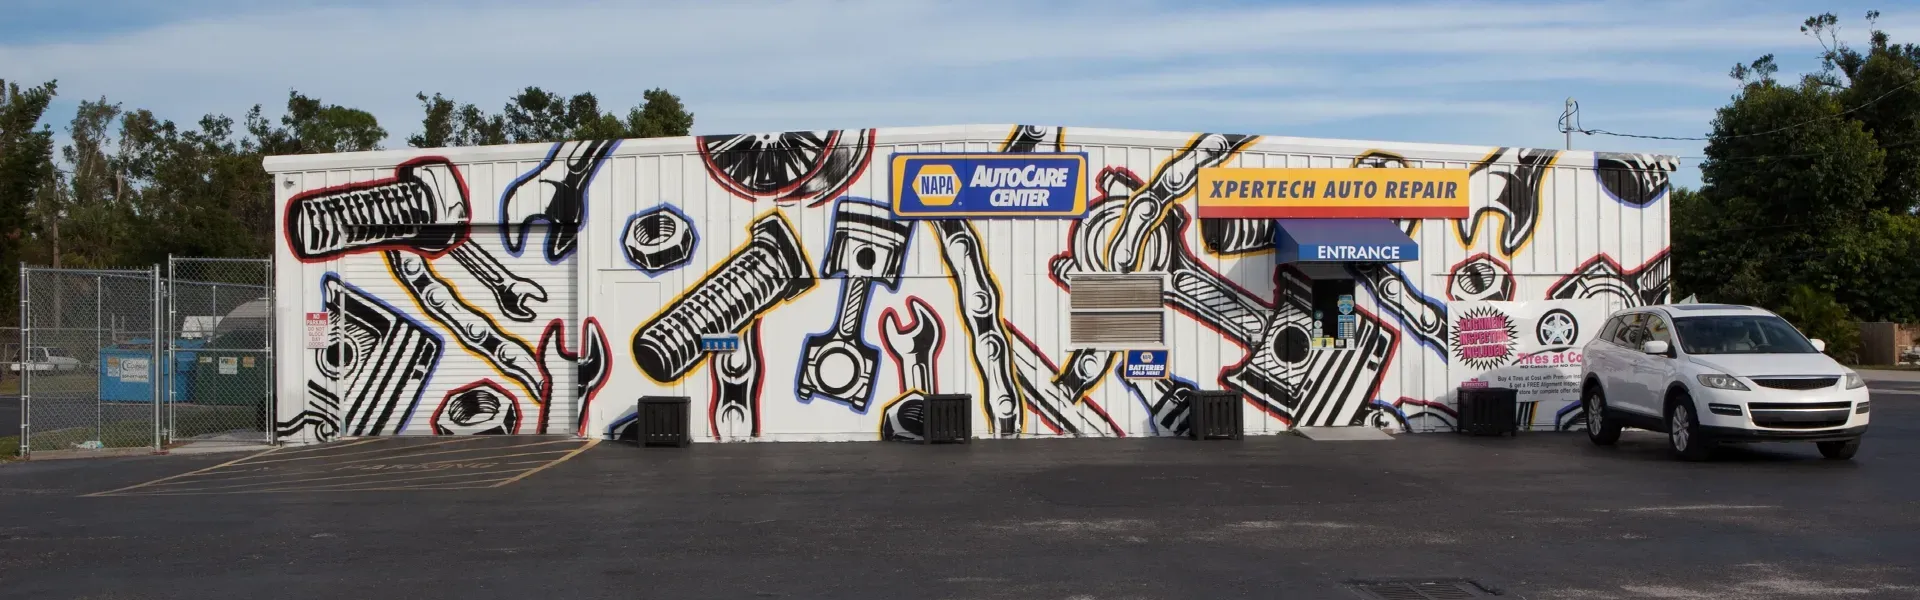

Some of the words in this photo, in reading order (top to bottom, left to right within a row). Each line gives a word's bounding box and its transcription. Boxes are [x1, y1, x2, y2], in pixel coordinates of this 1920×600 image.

[921, 175, 954, 195] NAPA
[1209, 180, 1317, 199] XPERTECH
[1323, 180, 1378, 199] AUTO
[1384, 181, 1458, 199] REPAIR
[989, 188, 1050, 207] CENTER
[1317, 245, 1400, 260] ENTRANCE
[1460, 316, 1506, 331] ALIGNMENT
[1460, 330, 1508, 345] INSPECTION
[1463, 345, 1507, 359] INCLUDED!
[1517, 353, 1549, 364] Tires
[1553, 353, 1564, 363] at
[1567, 352, 1582, 363] Co
[1541, 381, 1562, 389] Alignment
